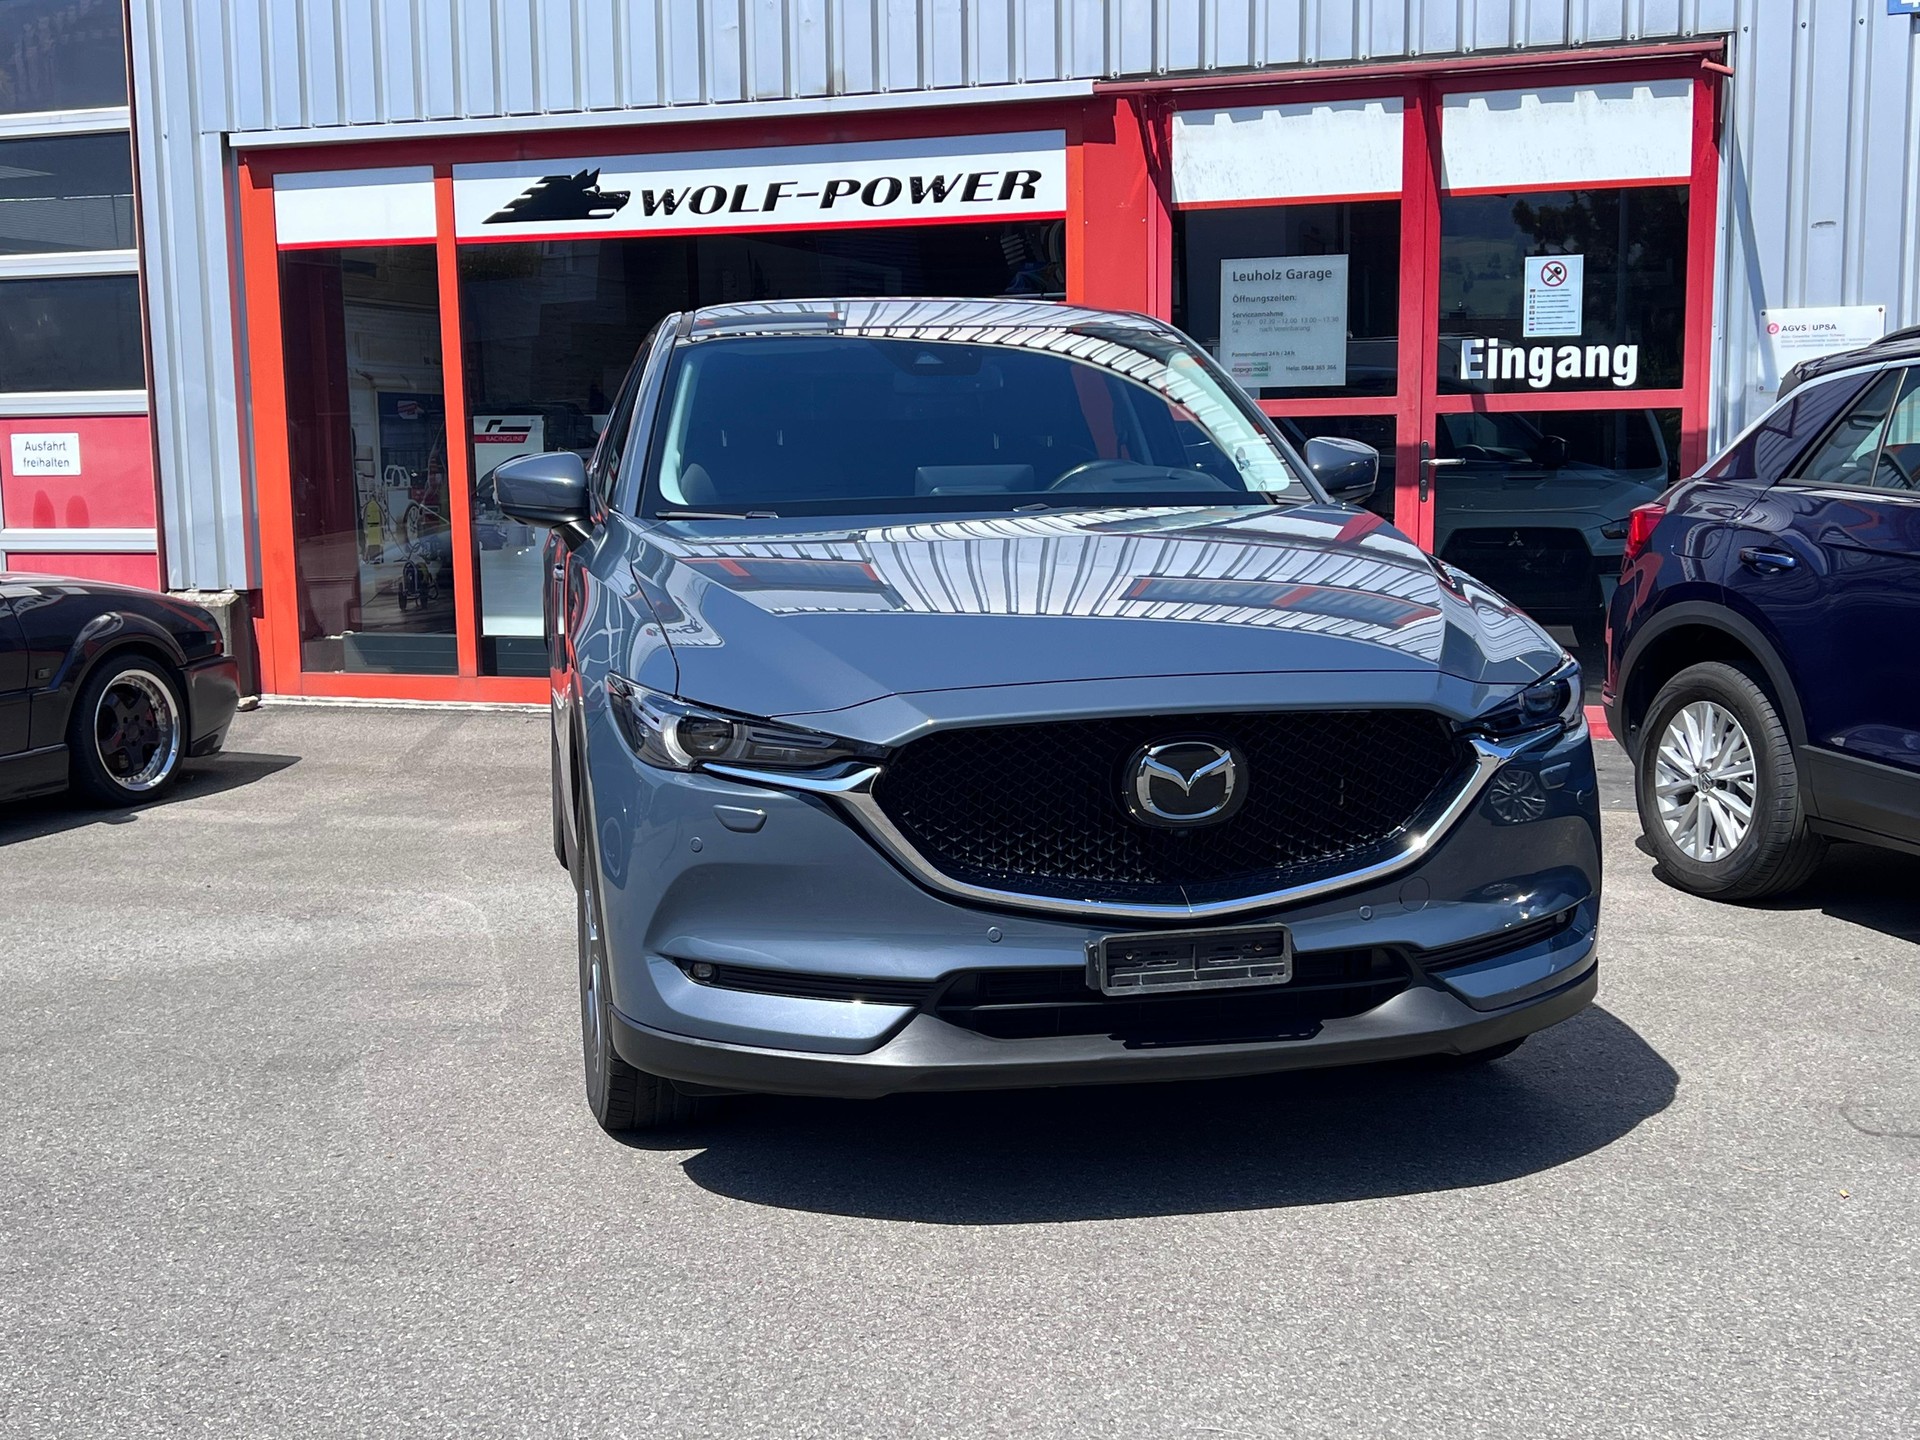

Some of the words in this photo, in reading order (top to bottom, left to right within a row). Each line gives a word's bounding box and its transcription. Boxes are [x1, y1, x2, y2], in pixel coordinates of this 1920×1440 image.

[641, 169, 1042, 217] WOLF-POWER
[1232, 269, 1282, 282] Leuholz
[1286, 268, 1333, 282] Garage
[1232, 294, 1297, 304] Öffnungszeiten:
[1781, 324, 1807, 332] AGVS
[1812, 323, 1837, 331] UPSA
[1460, 338, 1639, 389] Eingang
[25, 441, 67, 451] Ausfahrt
[23, 457, 70, 468] freihalten
